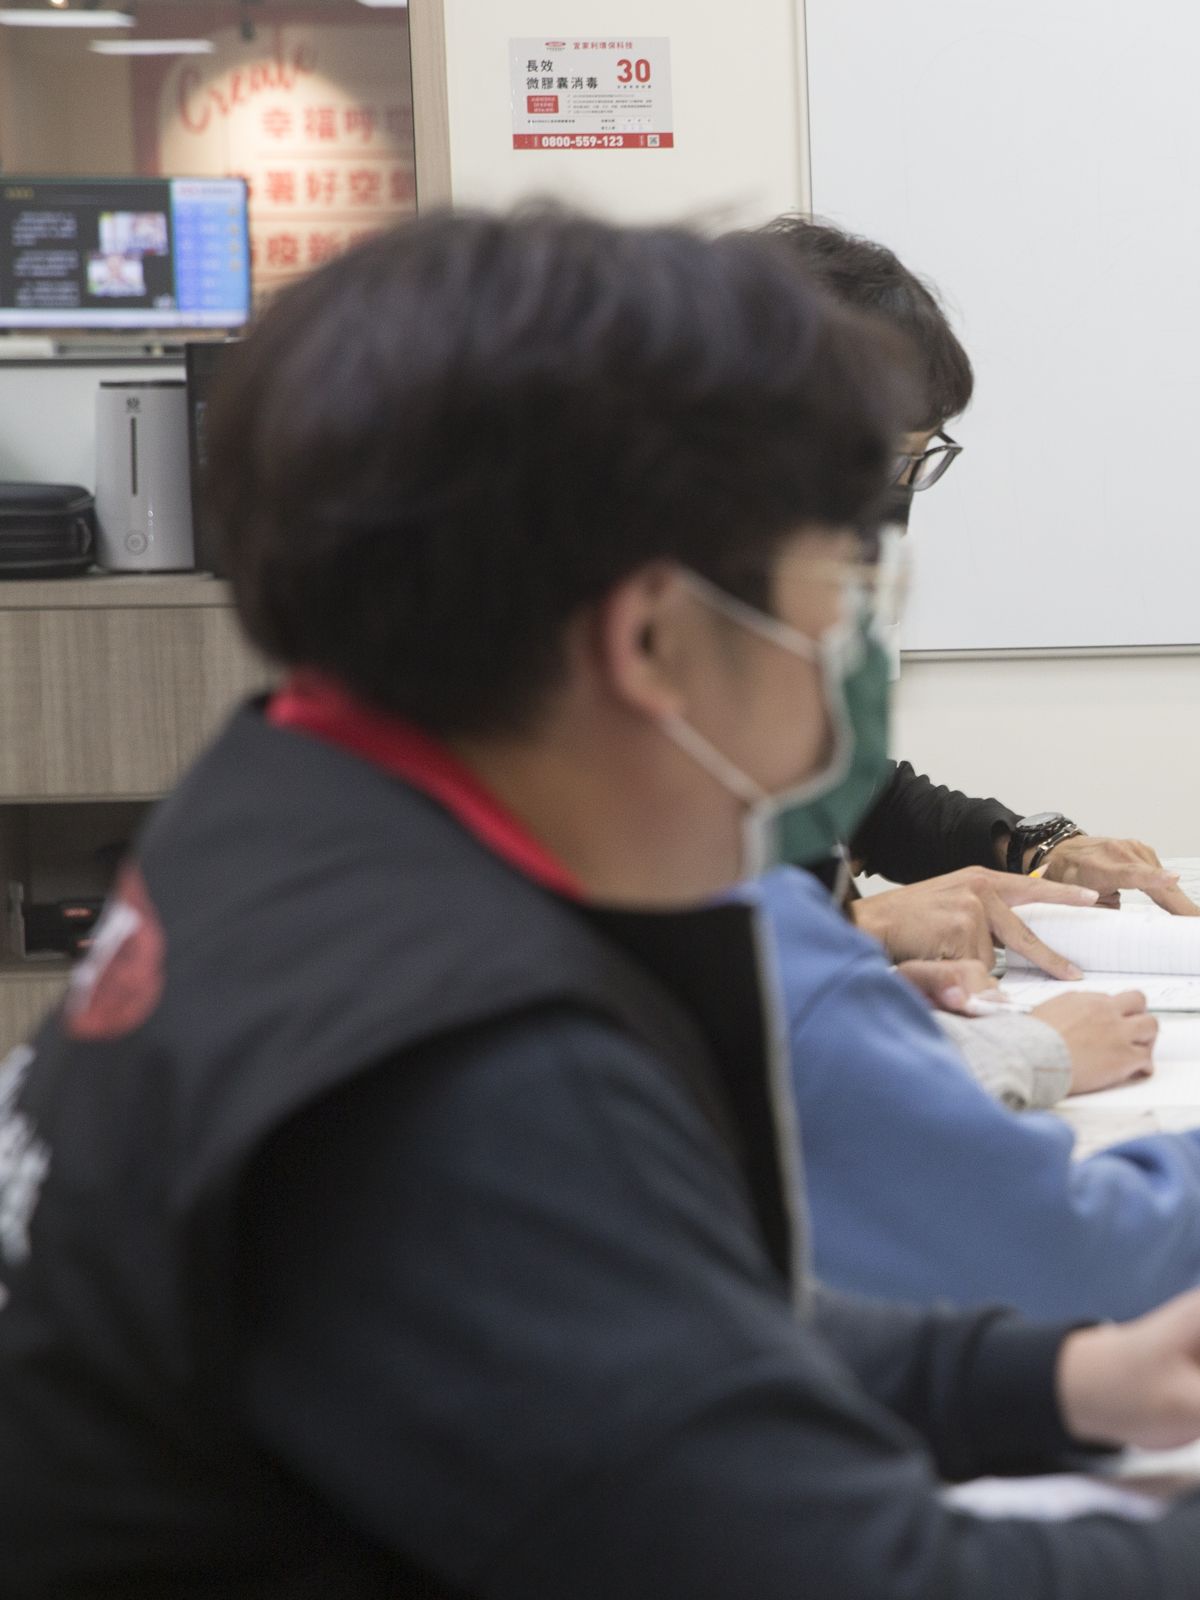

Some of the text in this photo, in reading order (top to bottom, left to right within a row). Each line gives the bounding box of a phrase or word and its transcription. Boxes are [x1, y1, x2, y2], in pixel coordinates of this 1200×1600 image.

[526, 59, 553, 73] 長效
[616, 58, 651, 83] 30
[526, 76, 599, 90] 微膠囊消毒
[541, 135, 624, 147] 0800-559-123
